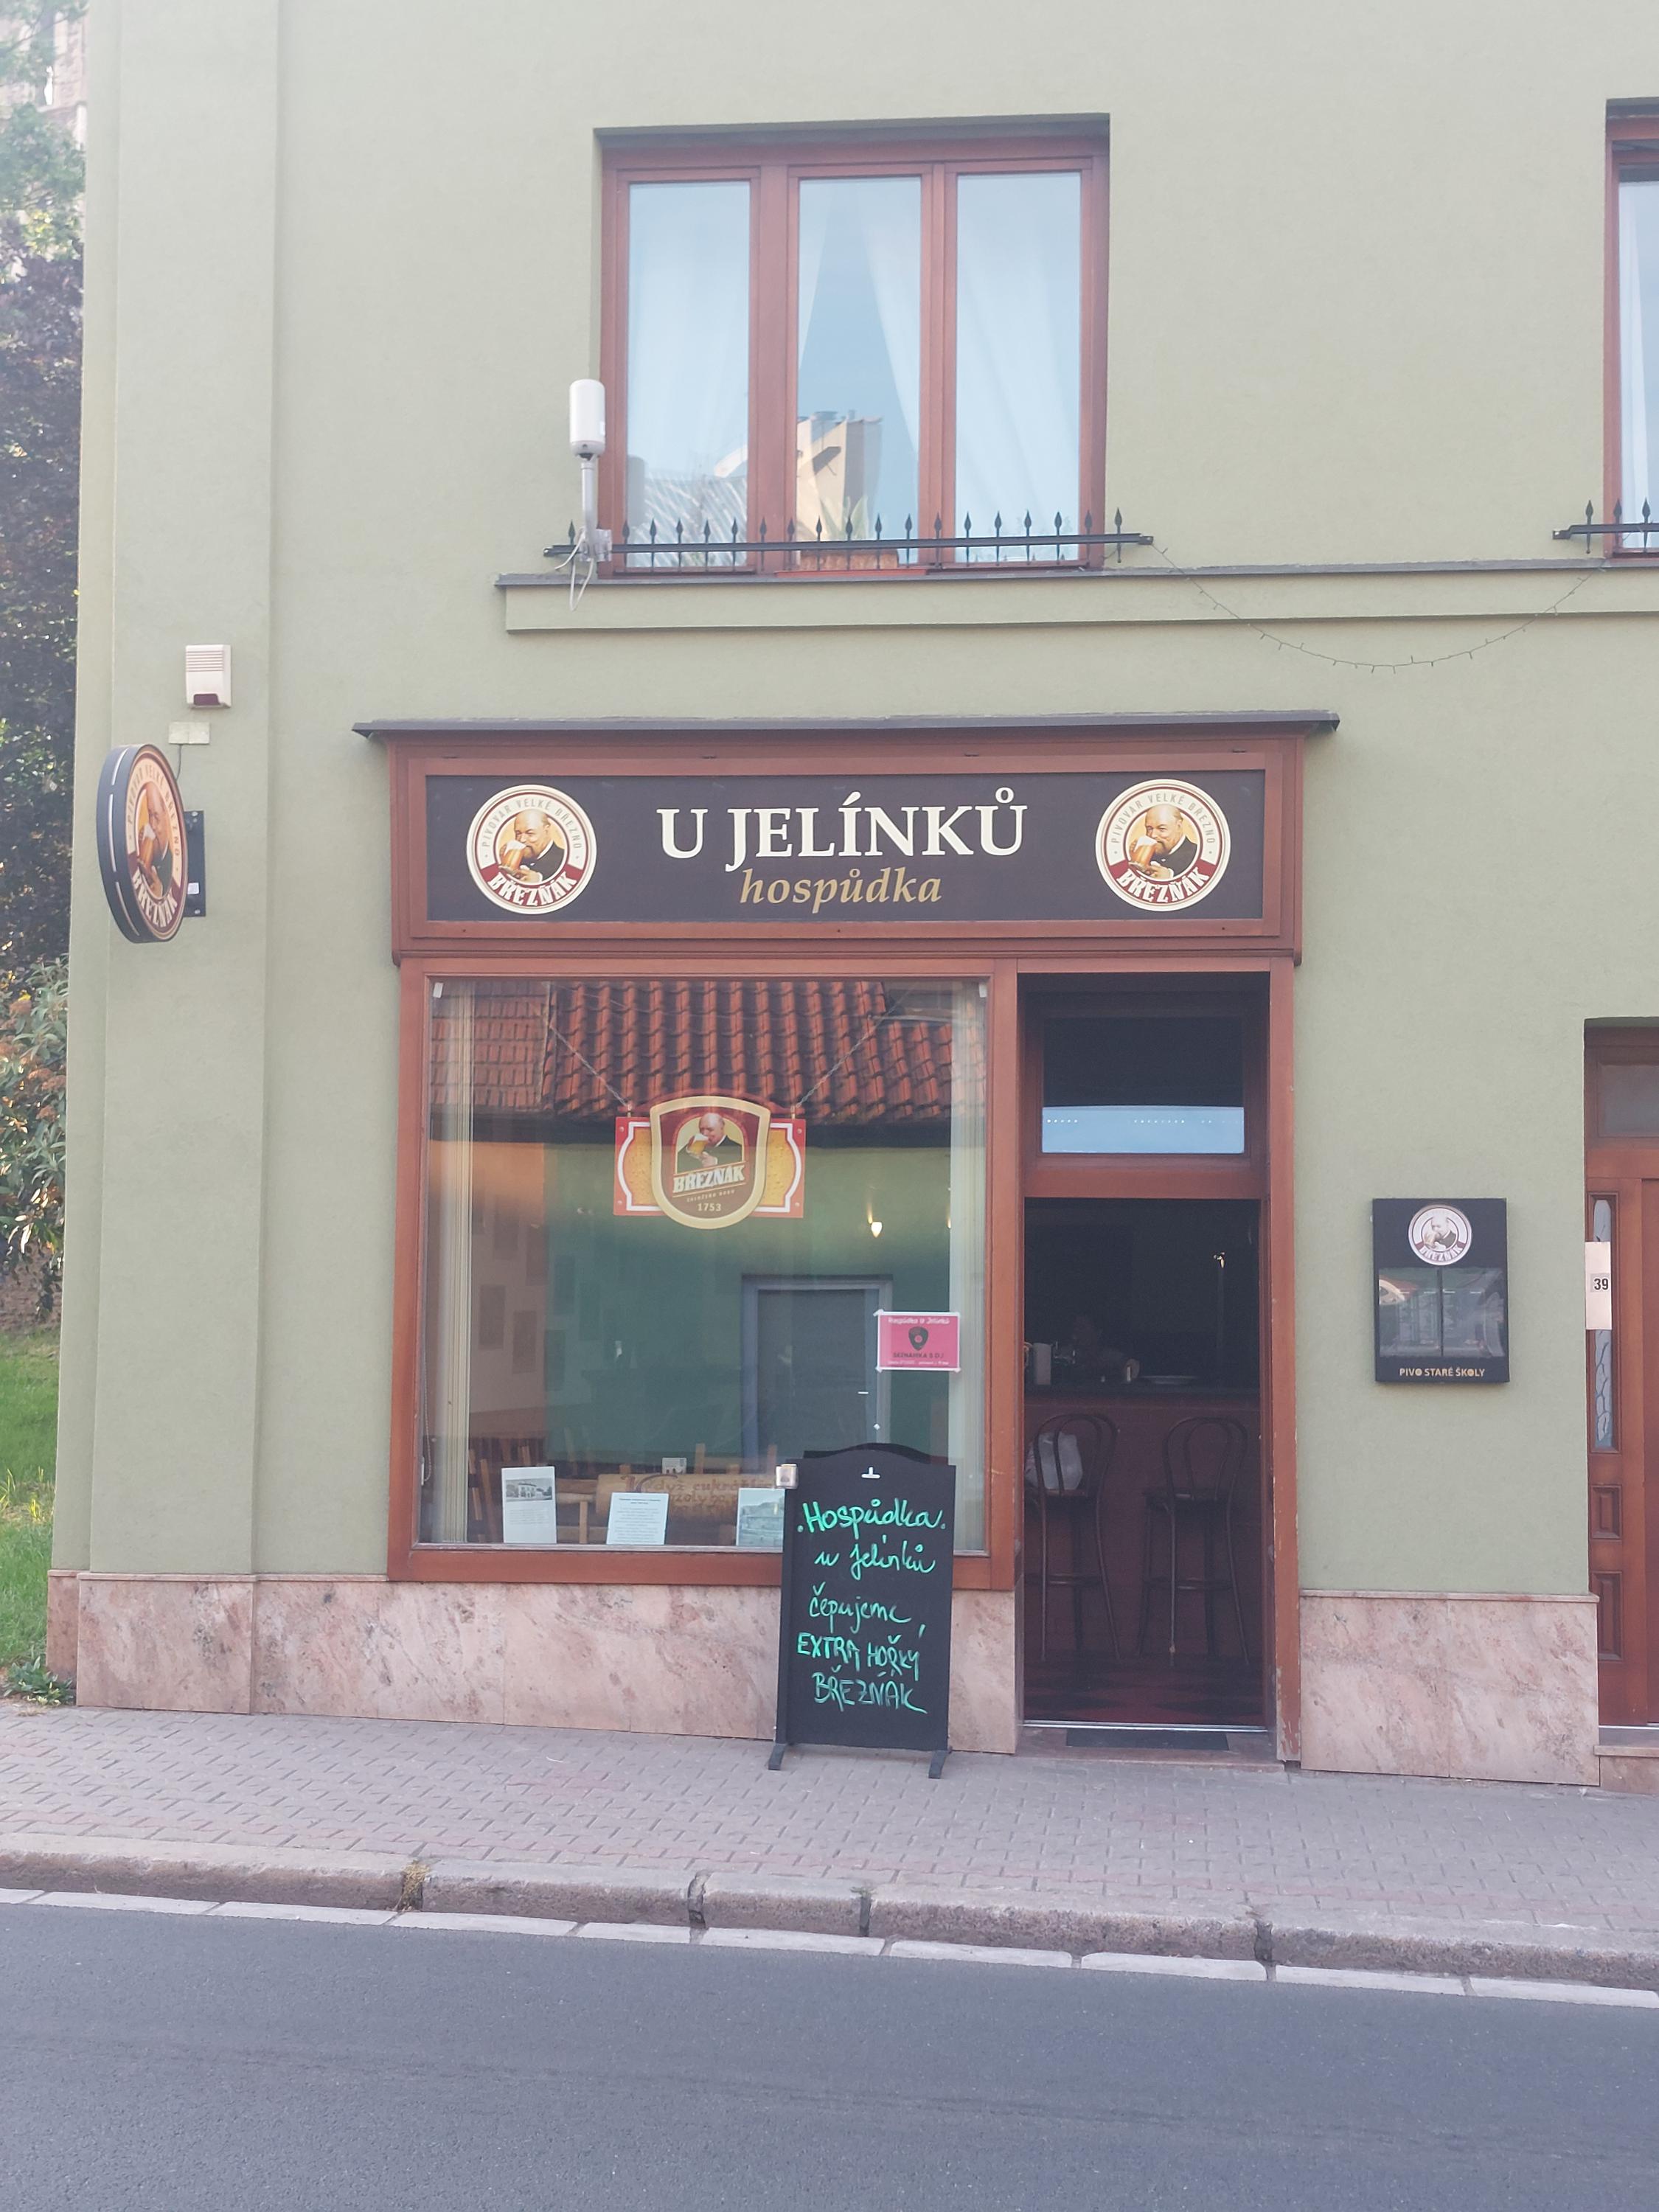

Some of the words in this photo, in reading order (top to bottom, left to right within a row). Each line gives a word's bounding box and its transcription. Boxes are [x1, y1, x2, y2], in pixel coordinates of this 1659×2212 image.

[481, 804, 512, 848] PIVOVAR
[516, 797, 552, 810] VELKÉ
[554, 806, 583, 849] BŘEZNO
[656, 808, 709, 859] U
[725, 787, 1028, 872] JELÍNKŮ
[1110, 801, 1143, 844] PIVOVAR
[1147, 792, 1185, 806] VELKÉ
[1188, 802, 1216, 844] BŘEZNO
[740, 866, 942, 914] hospůdka
[698, 1203, 722, 1211] 1753
[1593, 1278, 1609, 1290] 39
[1399, 1368, 1422, 1377] PIVO
[1424, 1366, 1454, 1377] STARÉ
[1455, 1366, 1485, 1377] ŠKOLY
[797, 1632, 860, 1672] EXTRA
